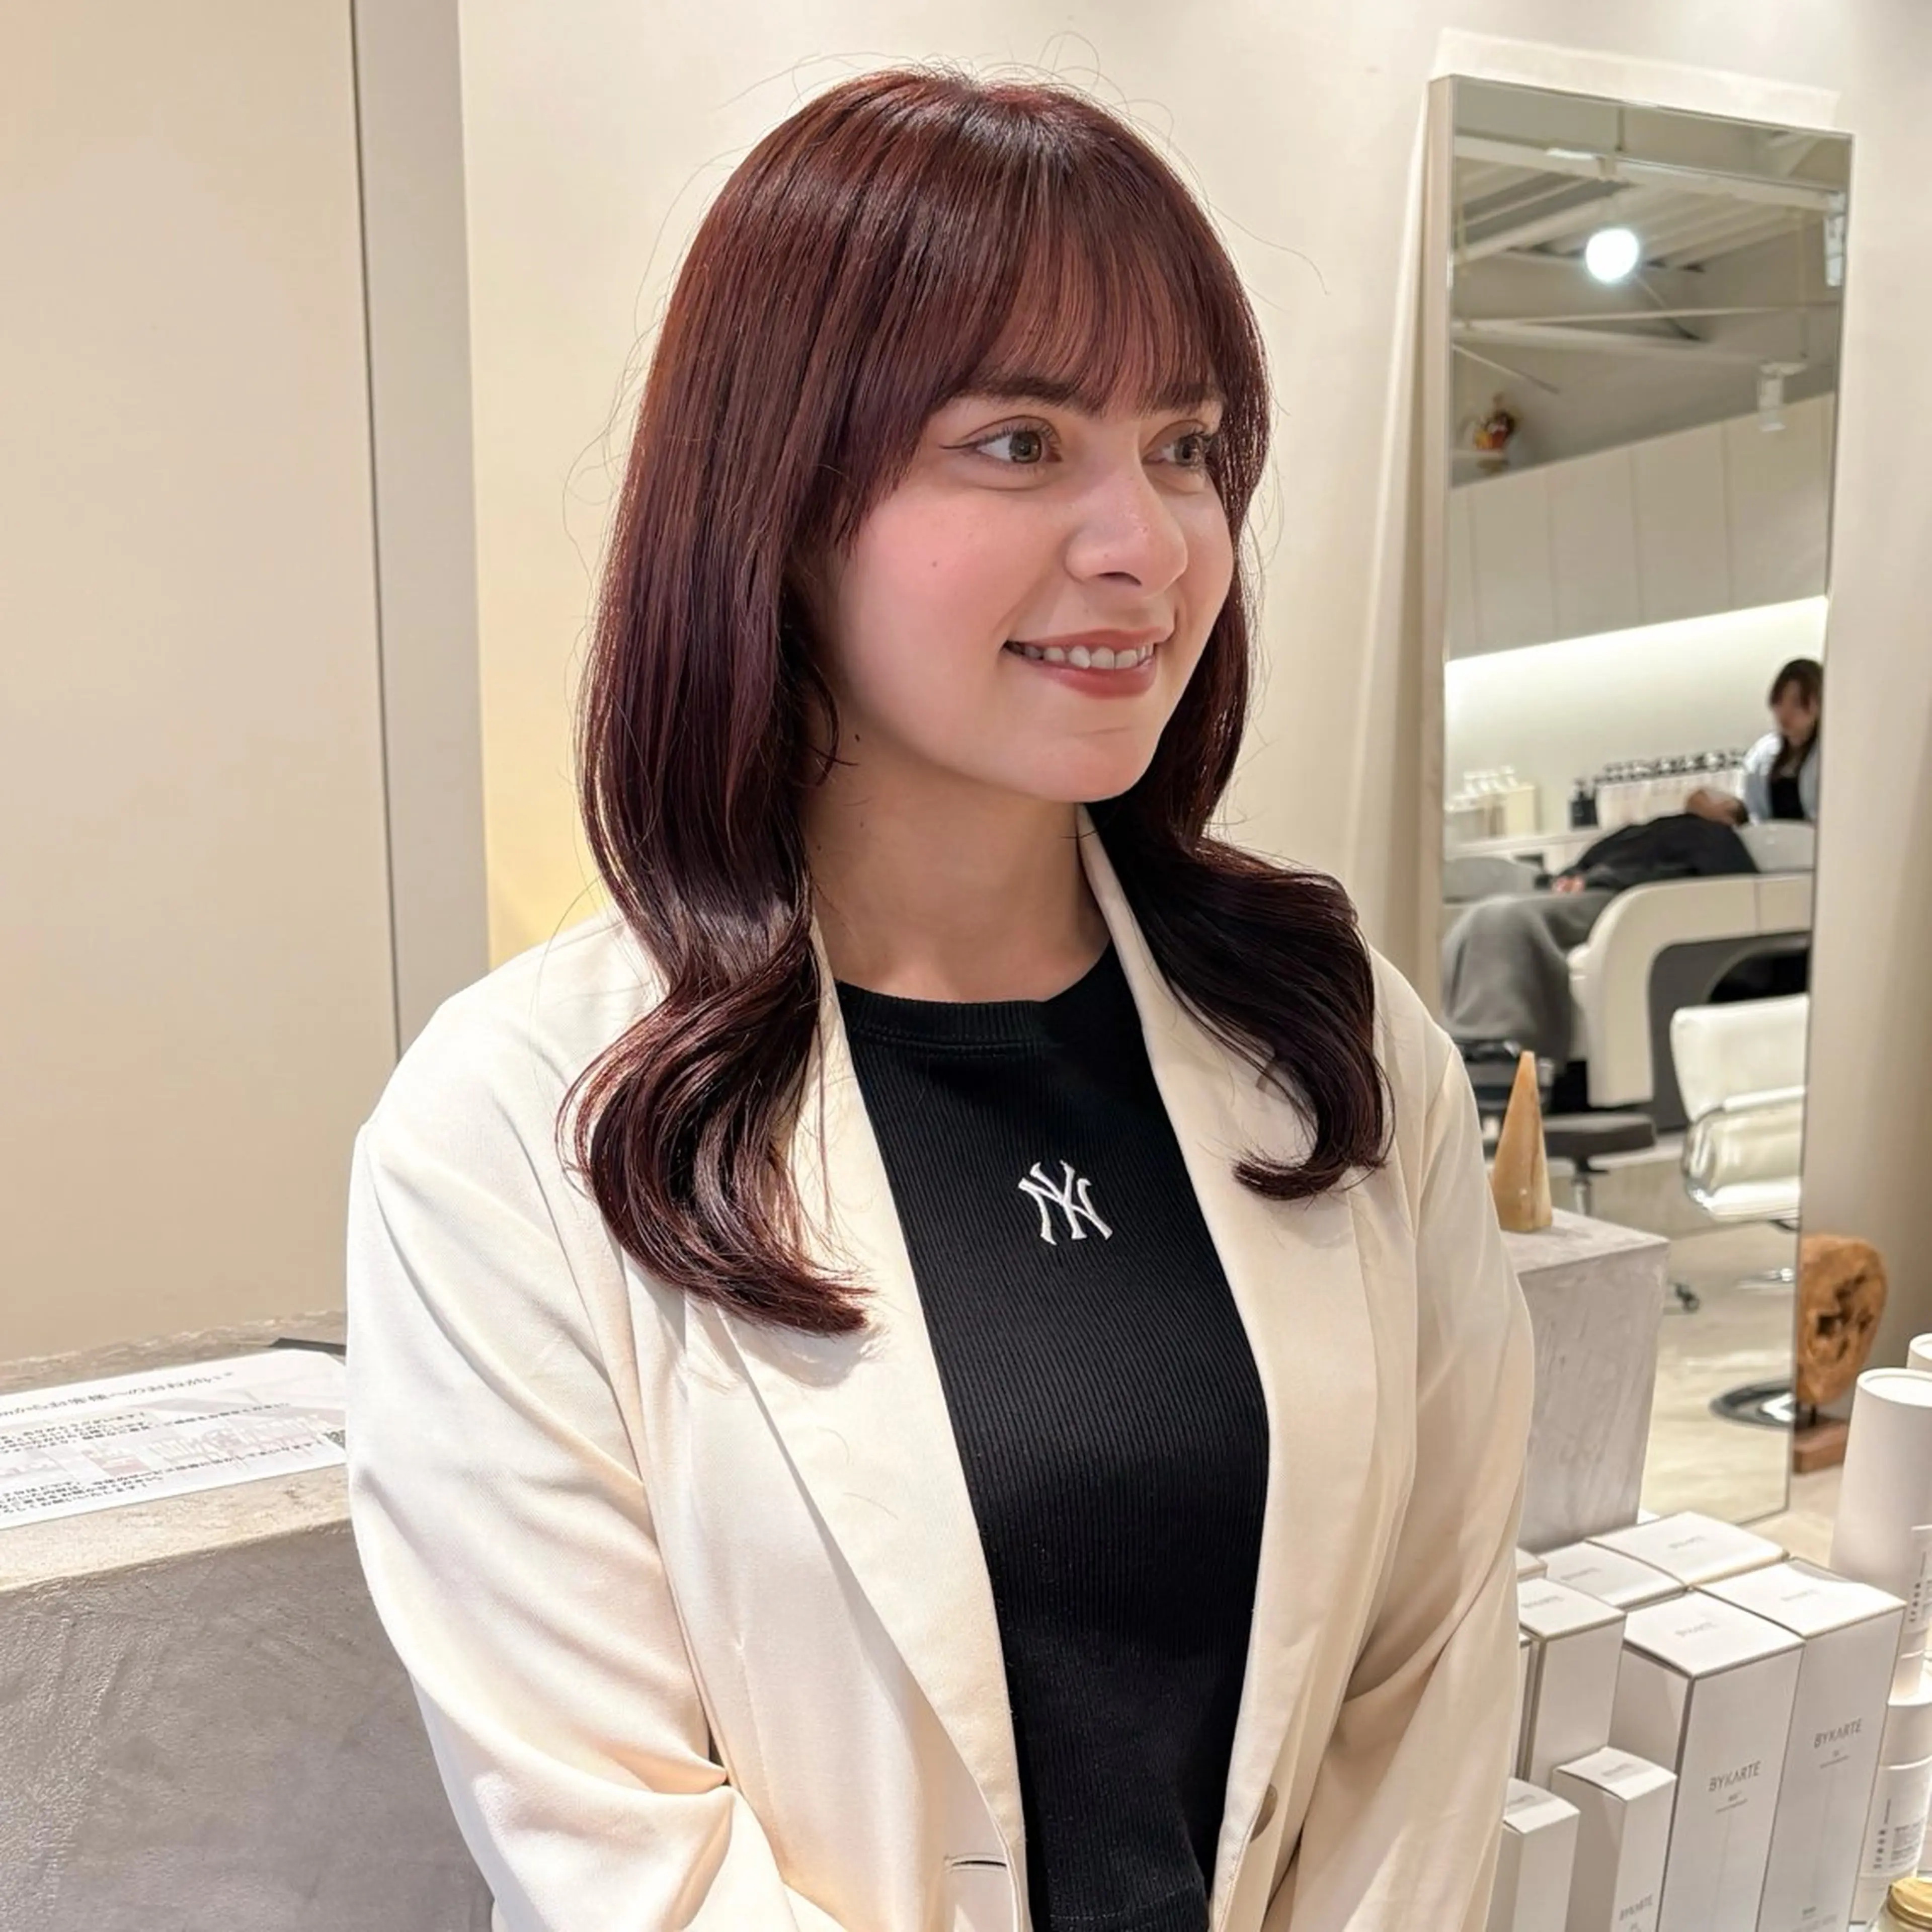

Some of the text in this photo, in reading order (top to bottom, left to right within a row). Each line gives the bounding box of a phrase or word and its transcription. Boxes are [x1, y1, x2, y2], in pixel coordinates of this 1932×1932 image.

[1018, 1159, 1113, 1246] NY
[1813, 1717, 1863, 1749] BYKARTE
[1709, 1760, 1761, 1792] BYKARTE
